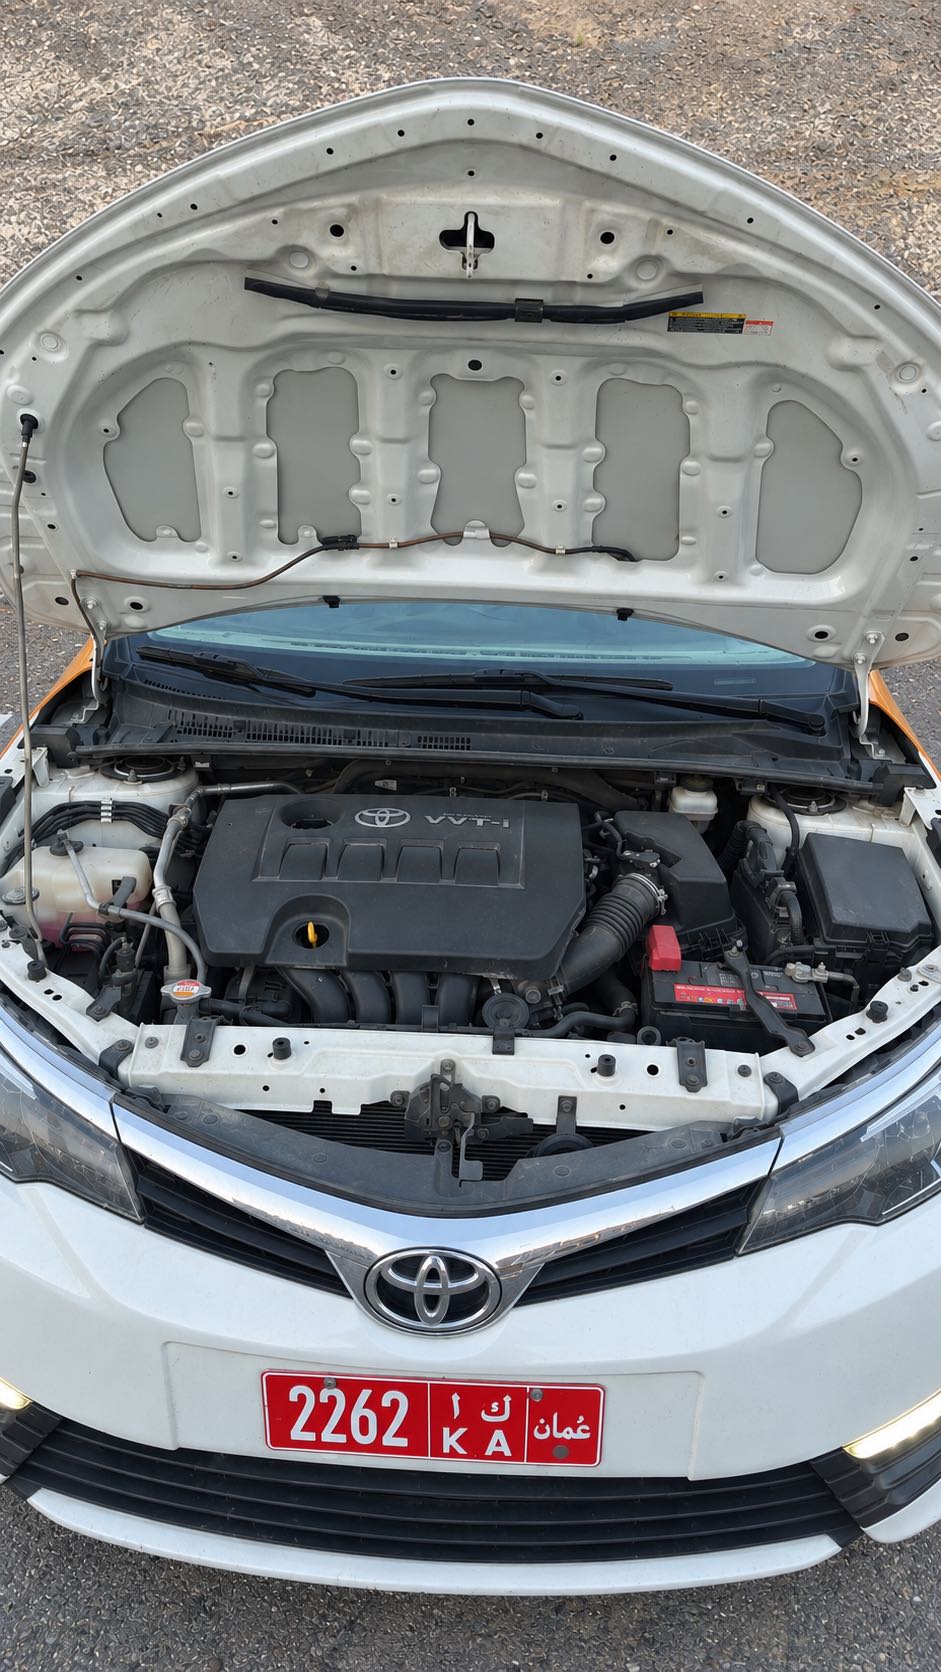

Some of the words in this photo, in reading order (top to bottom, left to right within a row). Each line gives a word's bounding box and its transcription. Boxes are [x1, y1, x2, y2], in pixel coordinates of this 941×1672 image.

[424, 815, 510, 828] VVT-i
[289, 1385, 409, 1447] 2262
[442, 1427, 469, 1455] K
[484, 1429, 512, 1457] A
